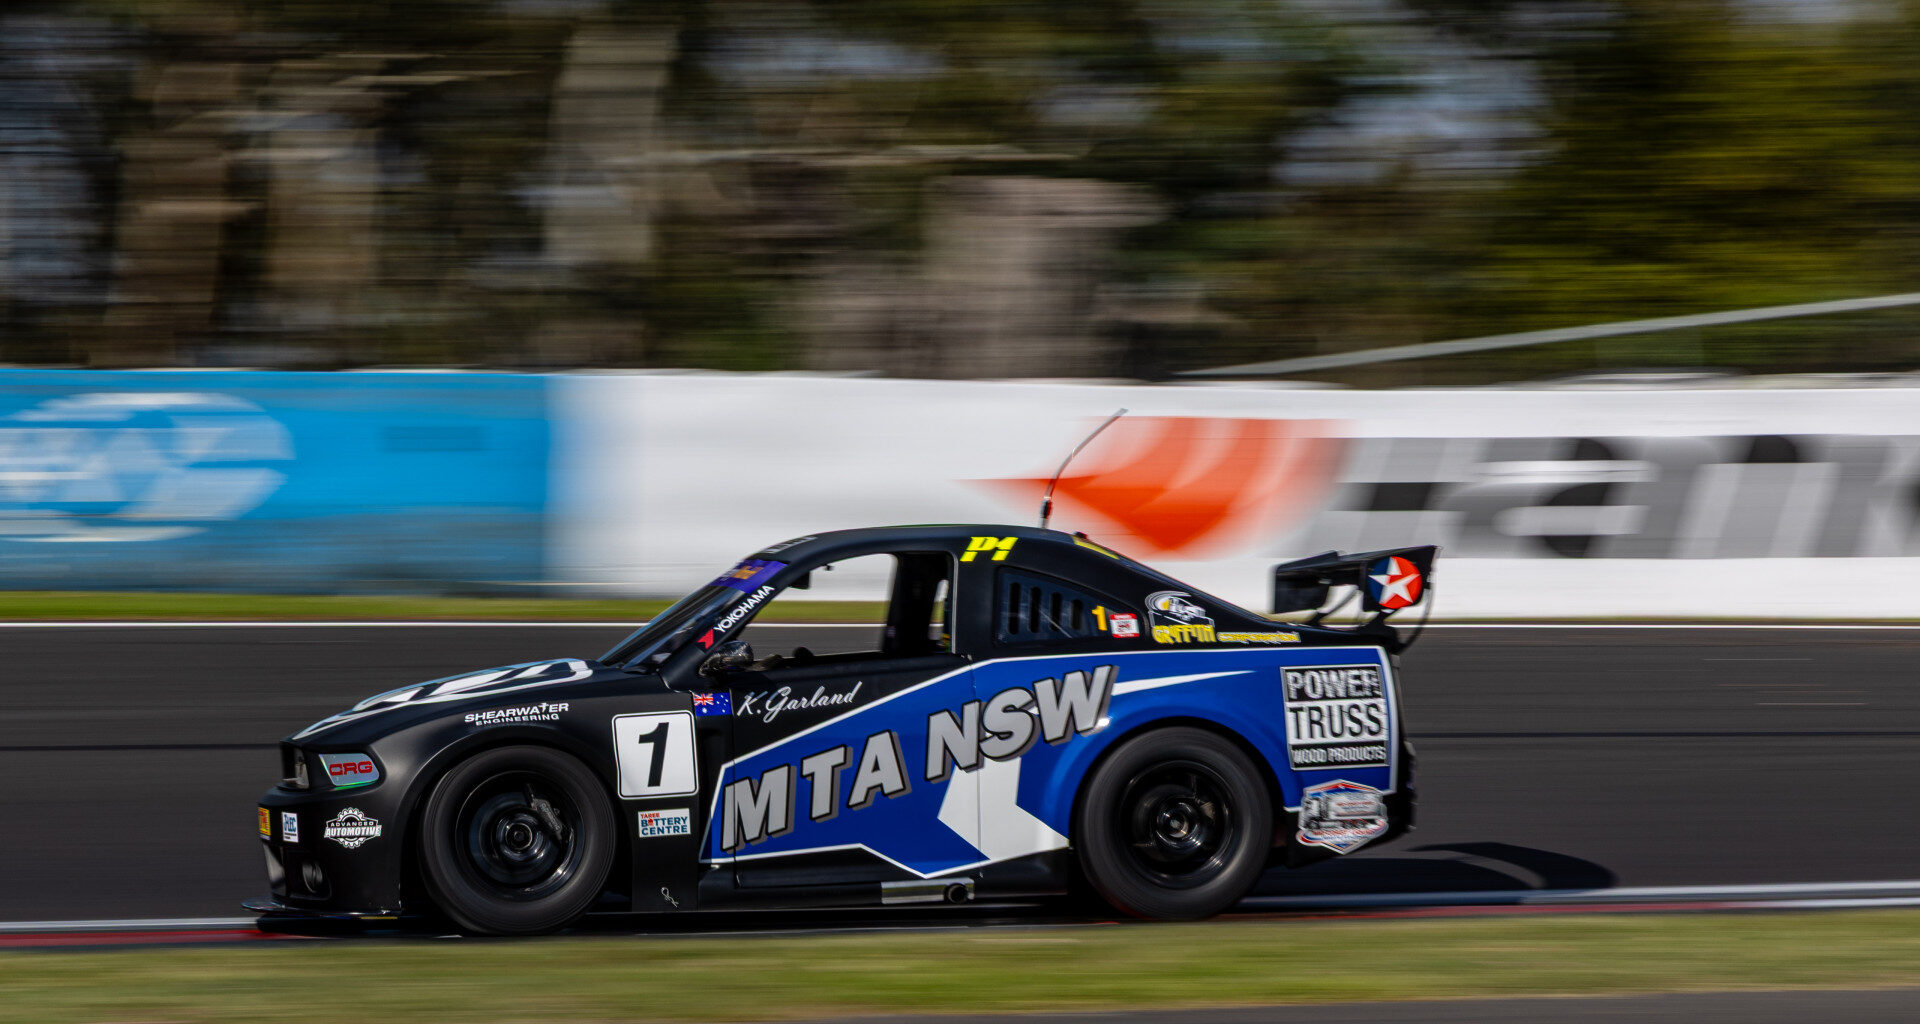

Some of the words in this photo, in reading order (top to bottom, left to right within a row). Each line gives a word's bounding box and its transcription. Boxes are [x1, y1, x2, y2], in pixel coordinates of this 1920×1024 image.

[713, 585, 775, 633] YOKOHAMA
[1091, 605, 1108, 631] 1
[1286, 669, 1383, 699] POWER
[464, 702, 570, 723] SHEARWATER
[475, 713, 560, 726] ENGINEERING
[1288, 703, 1383, 740] TRUSS
[637, 721, 670, 788] 1
[721, 729, 910, 853] MTA
[925, 664, 1118, 782] NSW
[1291, 748, 1328, 764] WOOD
[1327, 745, 1387, 762] PRODUCTS
[329, 760, 373, 776] CRG
[324, 824, 382, 838] AUTOMOTIVE
[641, 824, 688, 836] CENTRE
